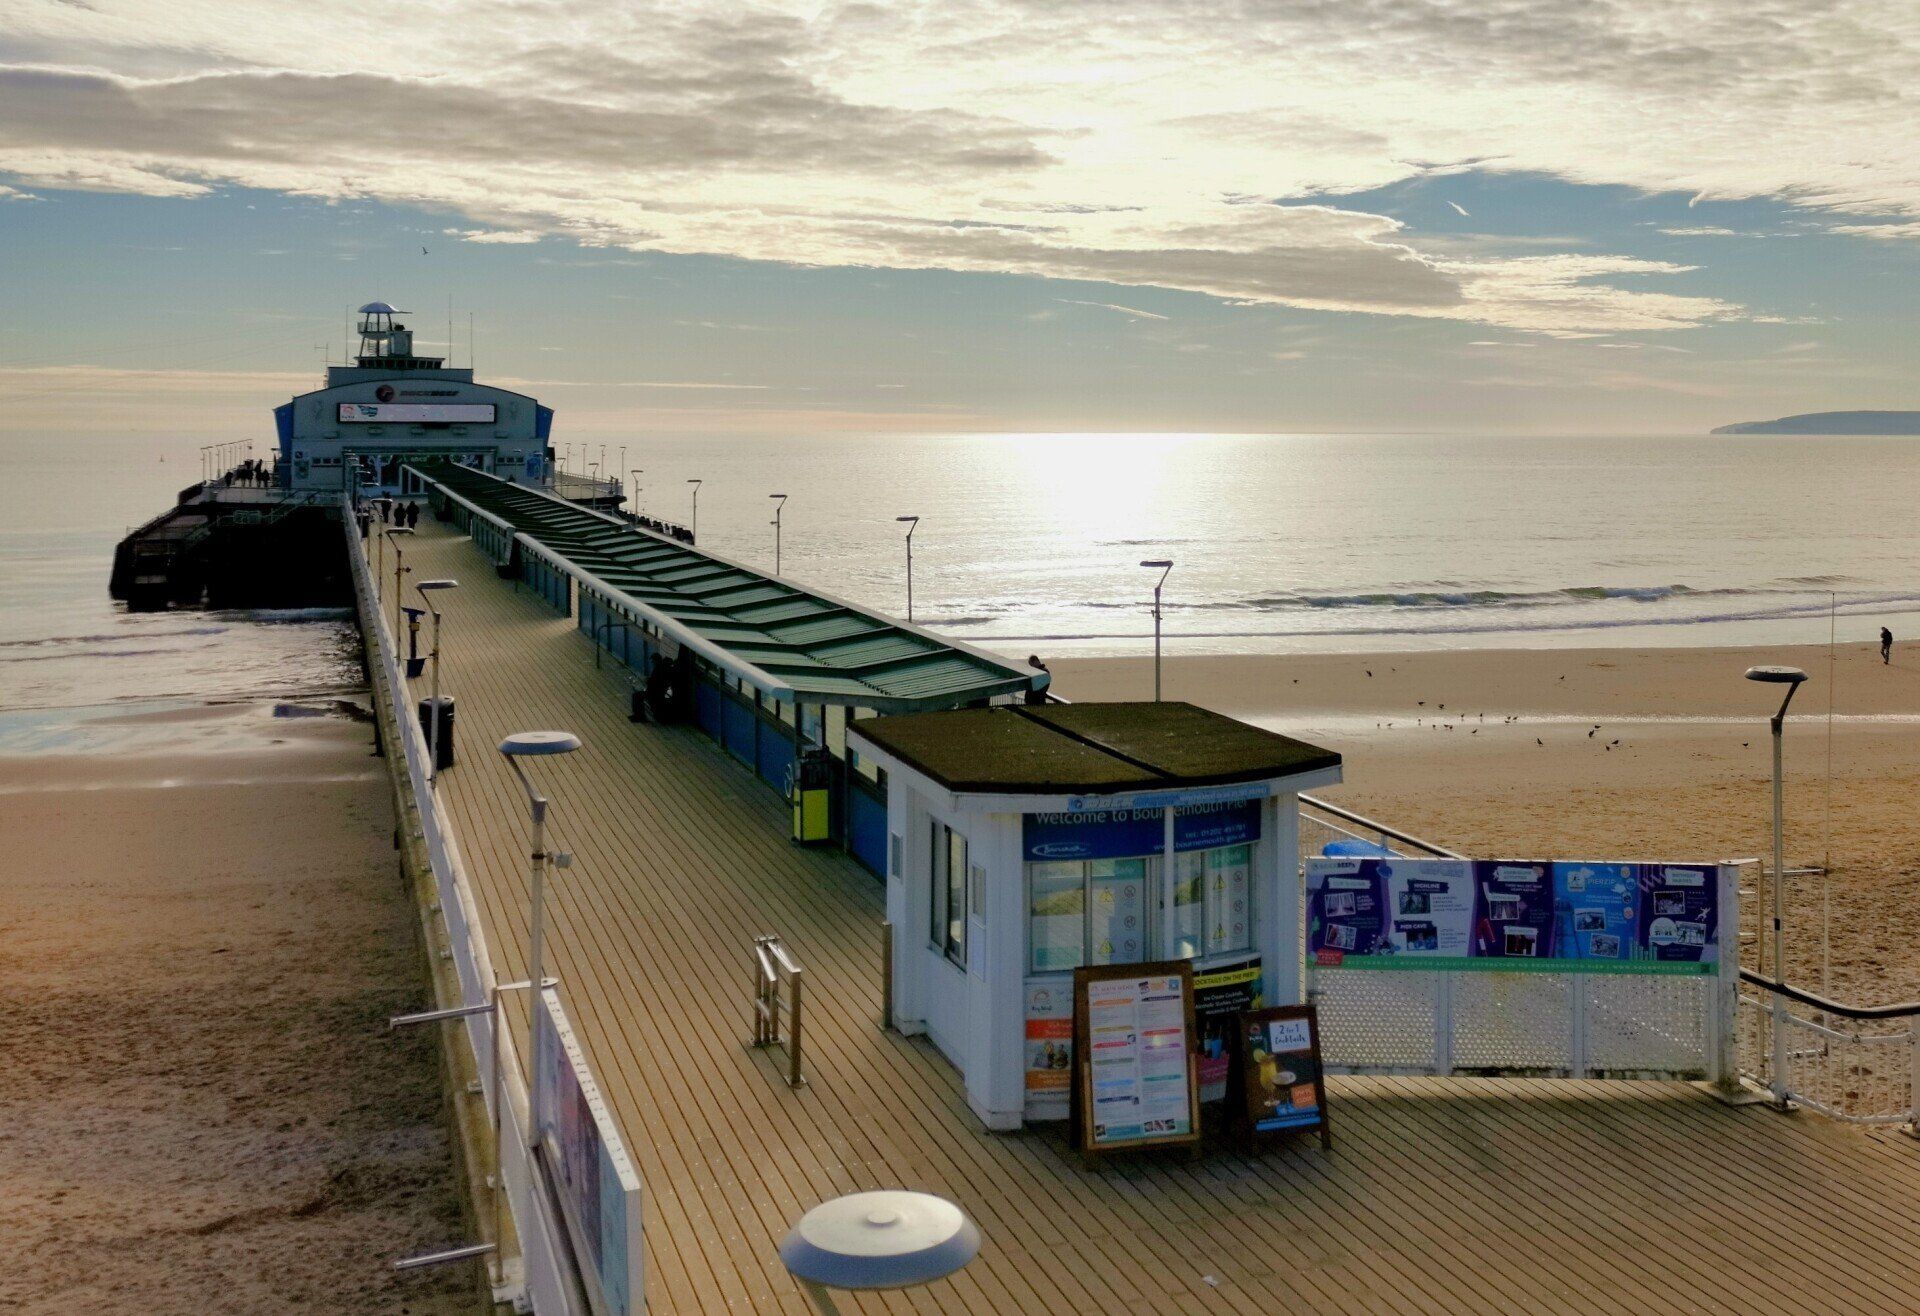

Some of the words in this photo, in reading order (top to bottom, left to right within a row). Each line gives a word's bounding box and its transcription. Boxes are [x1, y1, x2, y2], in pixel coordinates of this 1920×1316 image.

[1035, 812, 1105, 825] Welcome
[1112, 810, 1128, 822] to
[1279, 1024, 1285, 1035] 2
